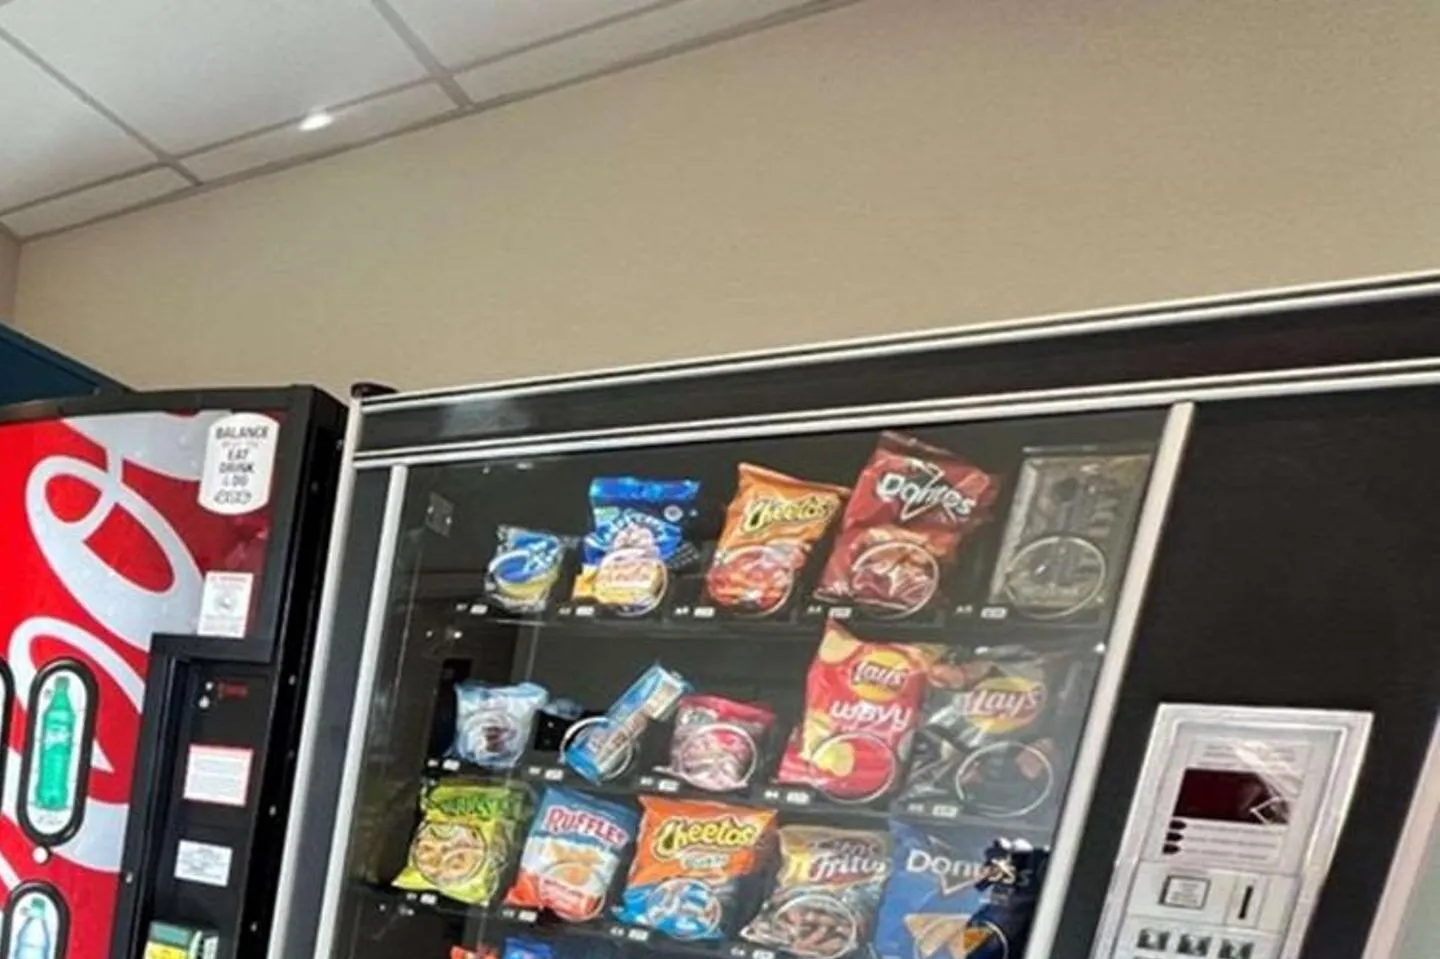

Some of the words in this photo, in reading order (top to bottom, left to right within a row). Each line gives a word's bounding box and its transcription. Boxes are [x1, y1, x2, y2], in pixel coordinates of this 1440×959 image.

[216, 425, 269, 439] BALANCE
[227, 448, 248, 460] EAT
[741, 495, 841, 534] Cheetos
[653, 816, 758, 860] Cheetos
